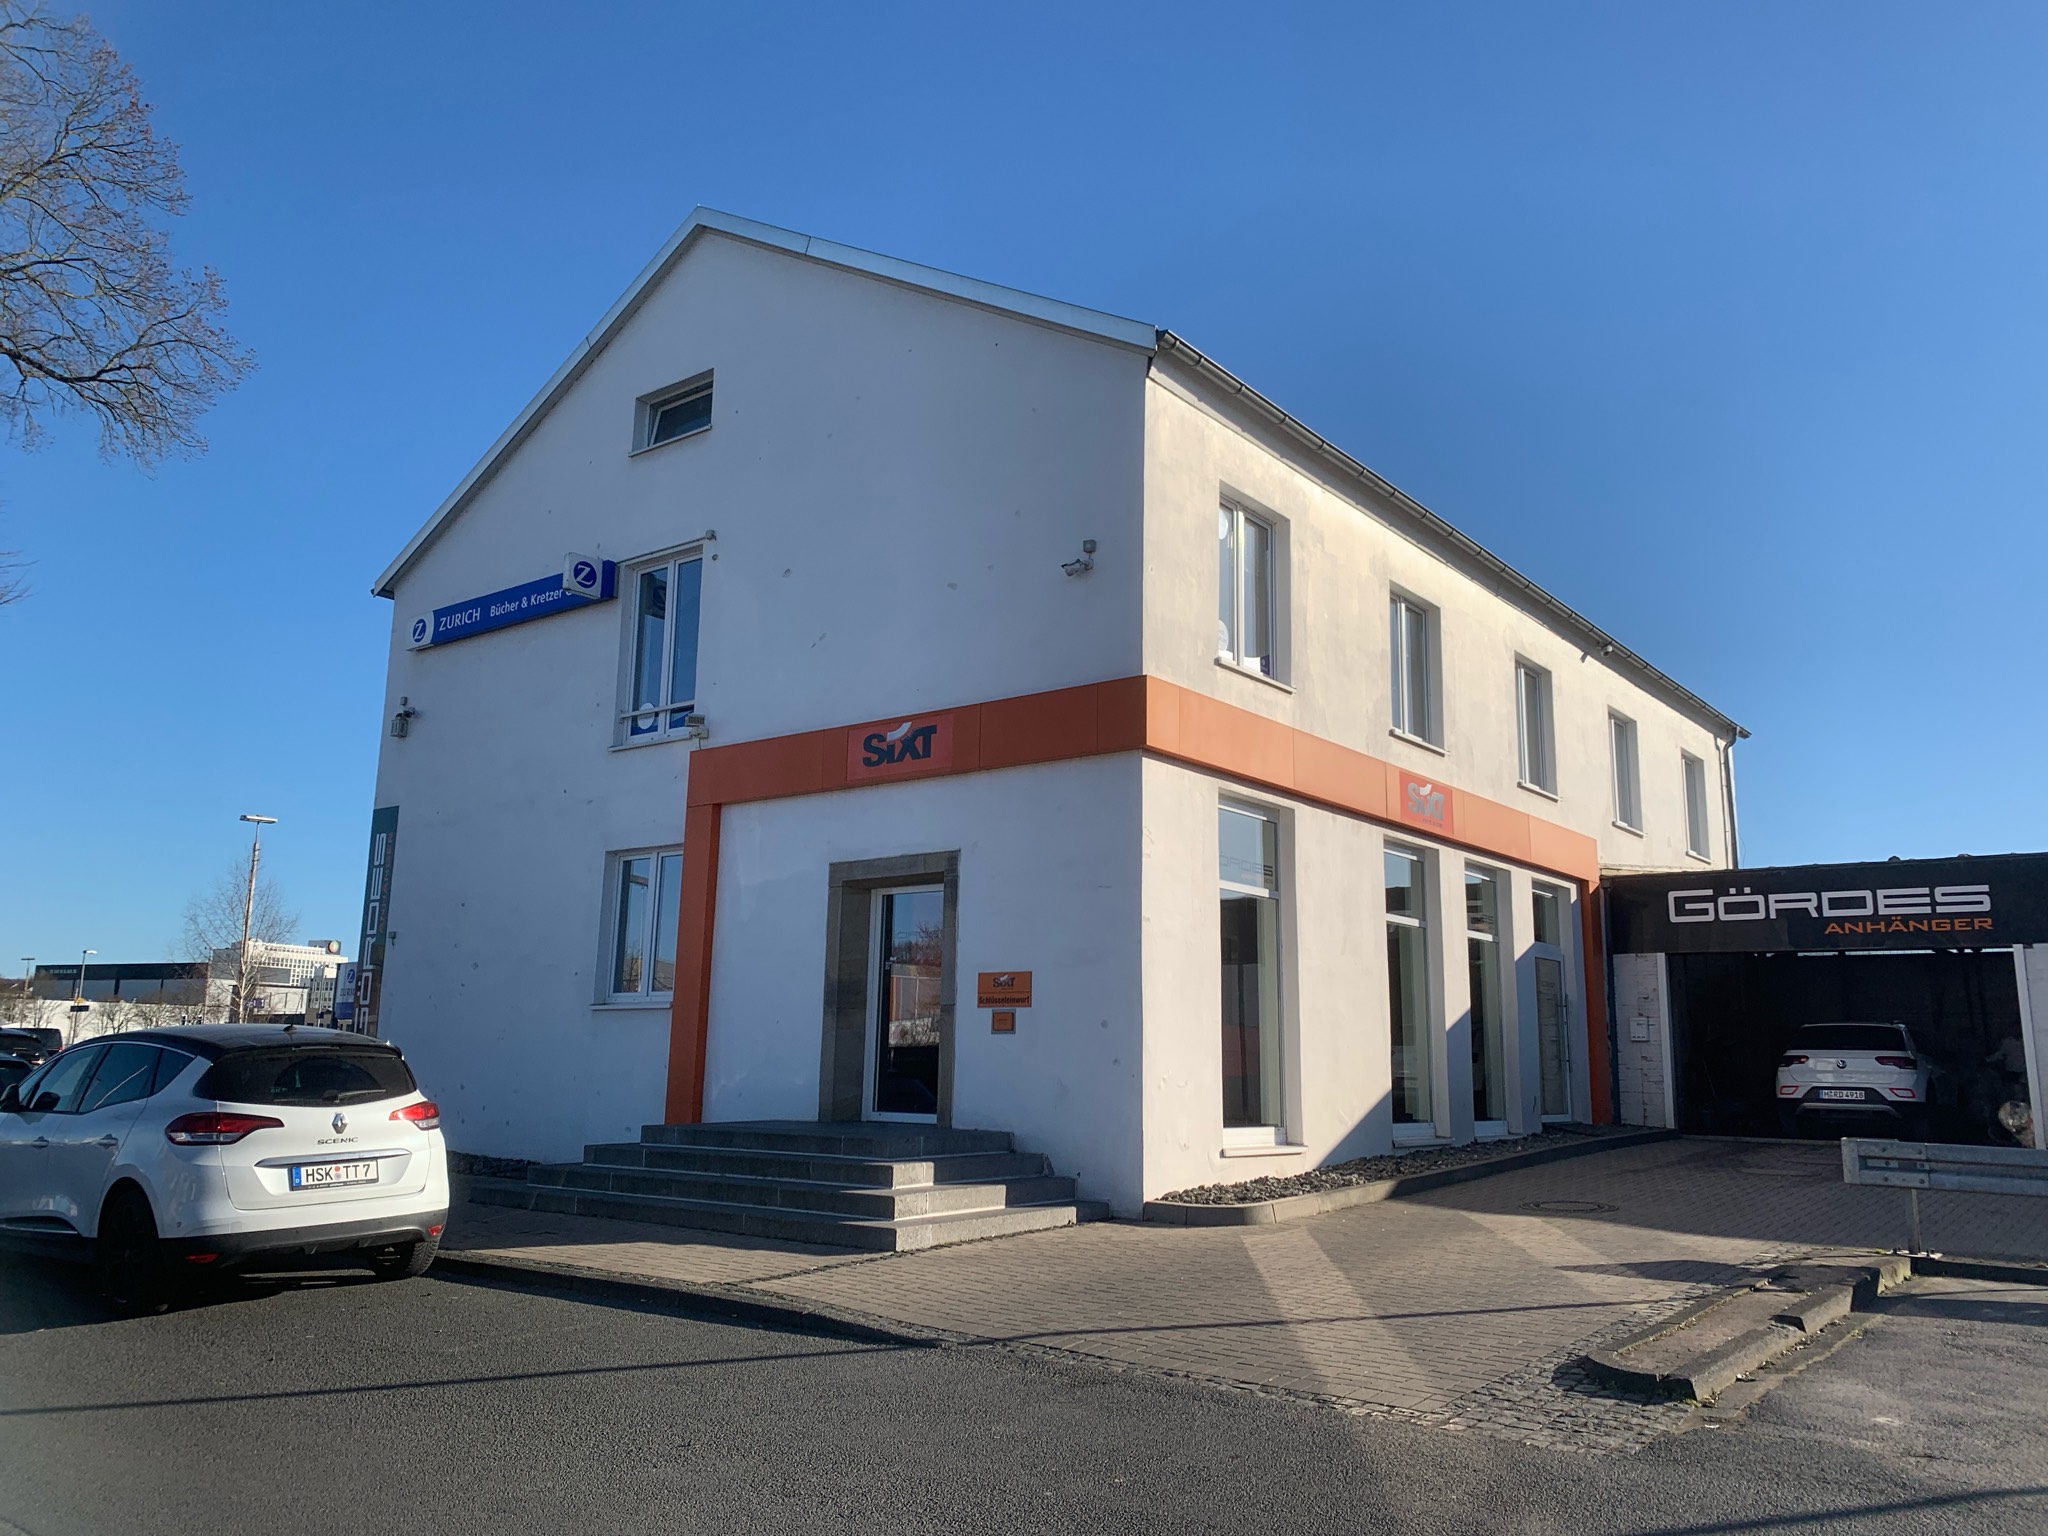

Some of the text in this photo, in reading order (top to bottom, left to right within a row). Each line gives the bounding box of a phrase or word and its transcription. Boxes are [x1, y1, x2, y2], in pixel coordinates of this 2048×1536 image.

[577, 565, 594, 586] Z
[438, 607, 481, 632] ZURICH
[489, 599, 519, 618] Bücher
[521, 597, 528, 608] &
[530, 588, 564, 606] Kretzer
[1667, 884, 1991, 923] GÖRDES
[1823, 915, 1994, 935] ANHÄNGER
[317, 1137, 358, 1145] SCENIC
[306, 1167, 333, 1183] HSK
[343, 1164, 360, 1179] TT
[363, 1164, 370, 1177] 7
